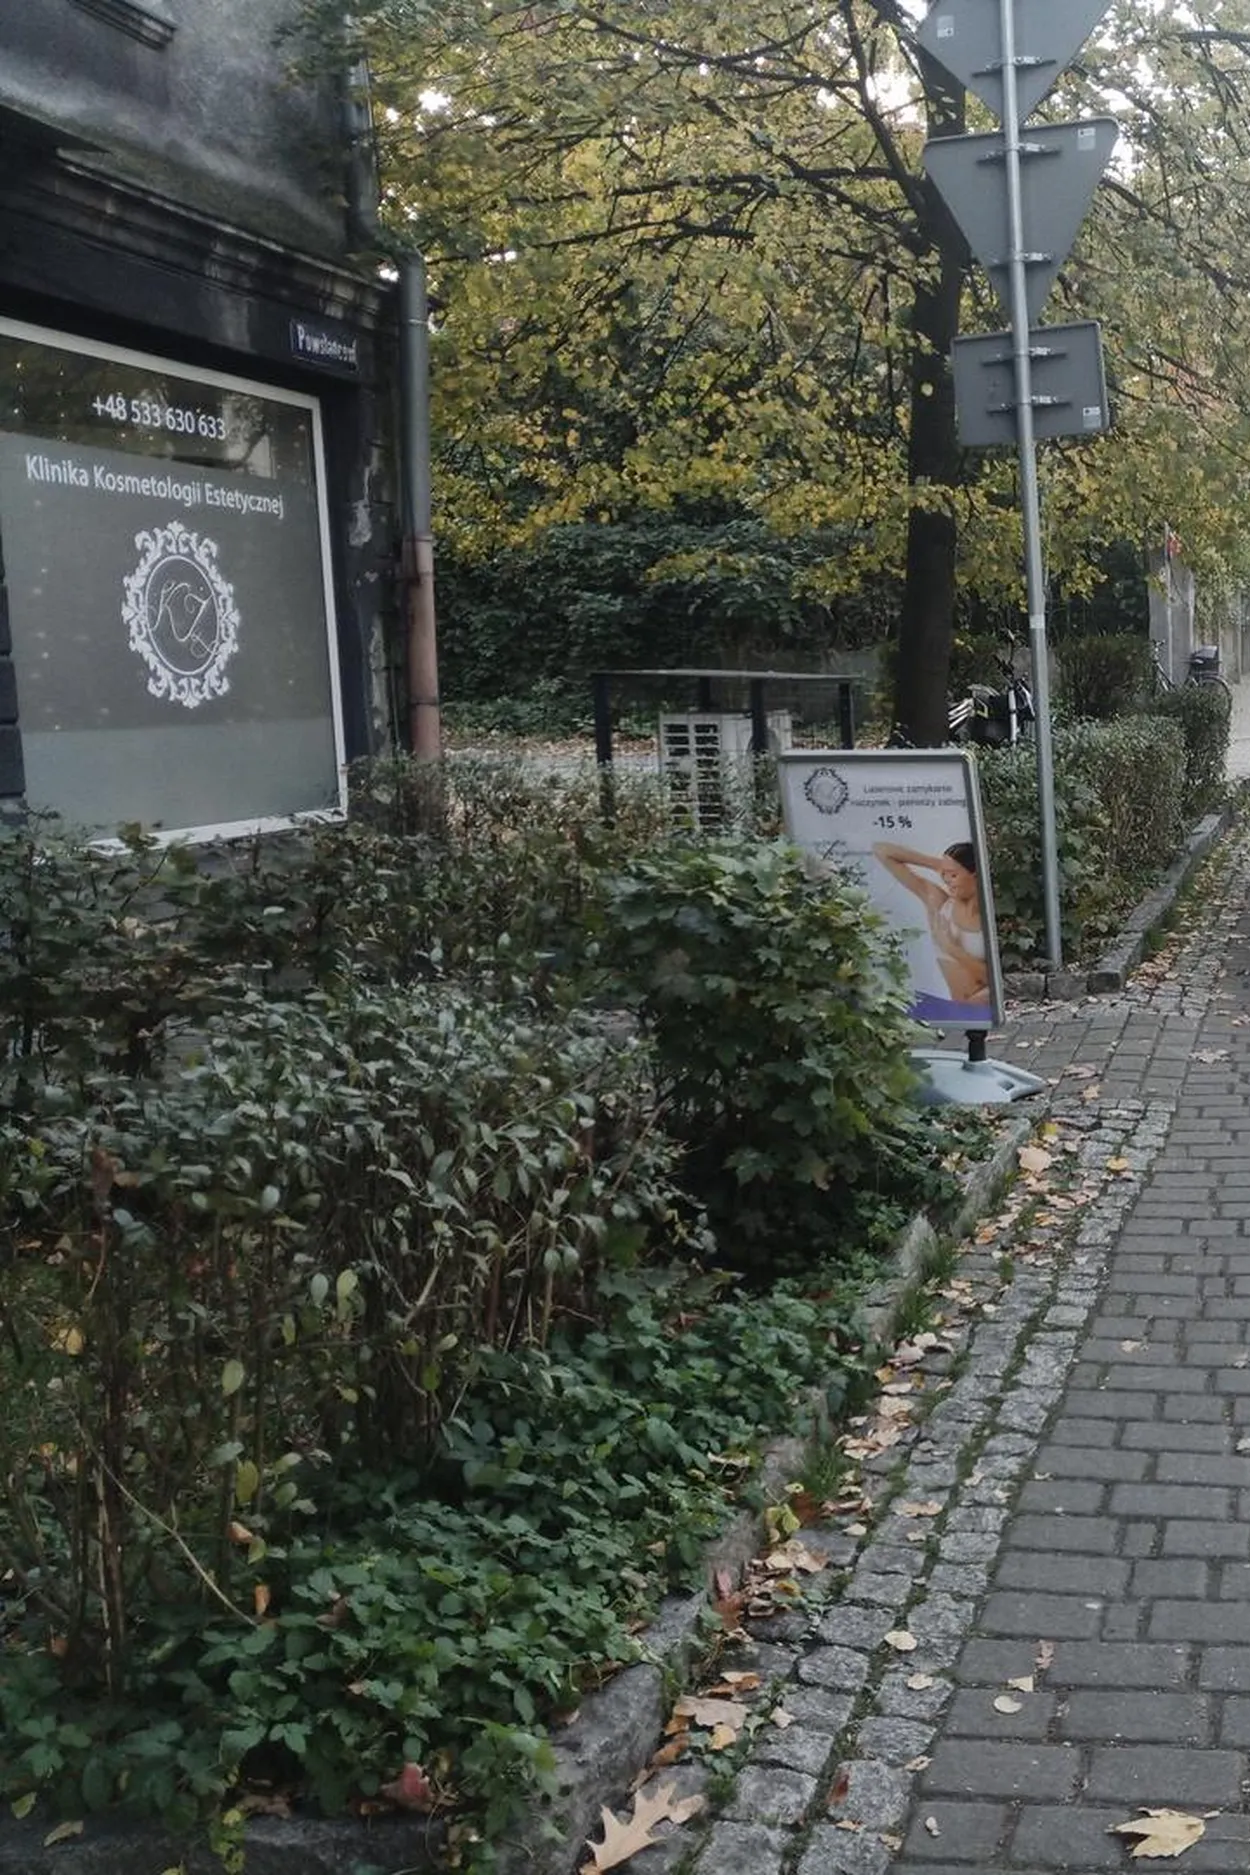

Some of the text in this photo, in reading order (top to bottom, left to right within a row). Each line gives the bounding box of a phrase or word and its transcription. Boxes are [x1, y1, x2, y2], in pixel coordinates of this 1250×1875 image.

[92, 394, 226, 440] +48 533 630 633
[25, 454, 285, 520] Klinika Kosmetologii Estetycznej
[873, 815, 913, 829] -15 %
